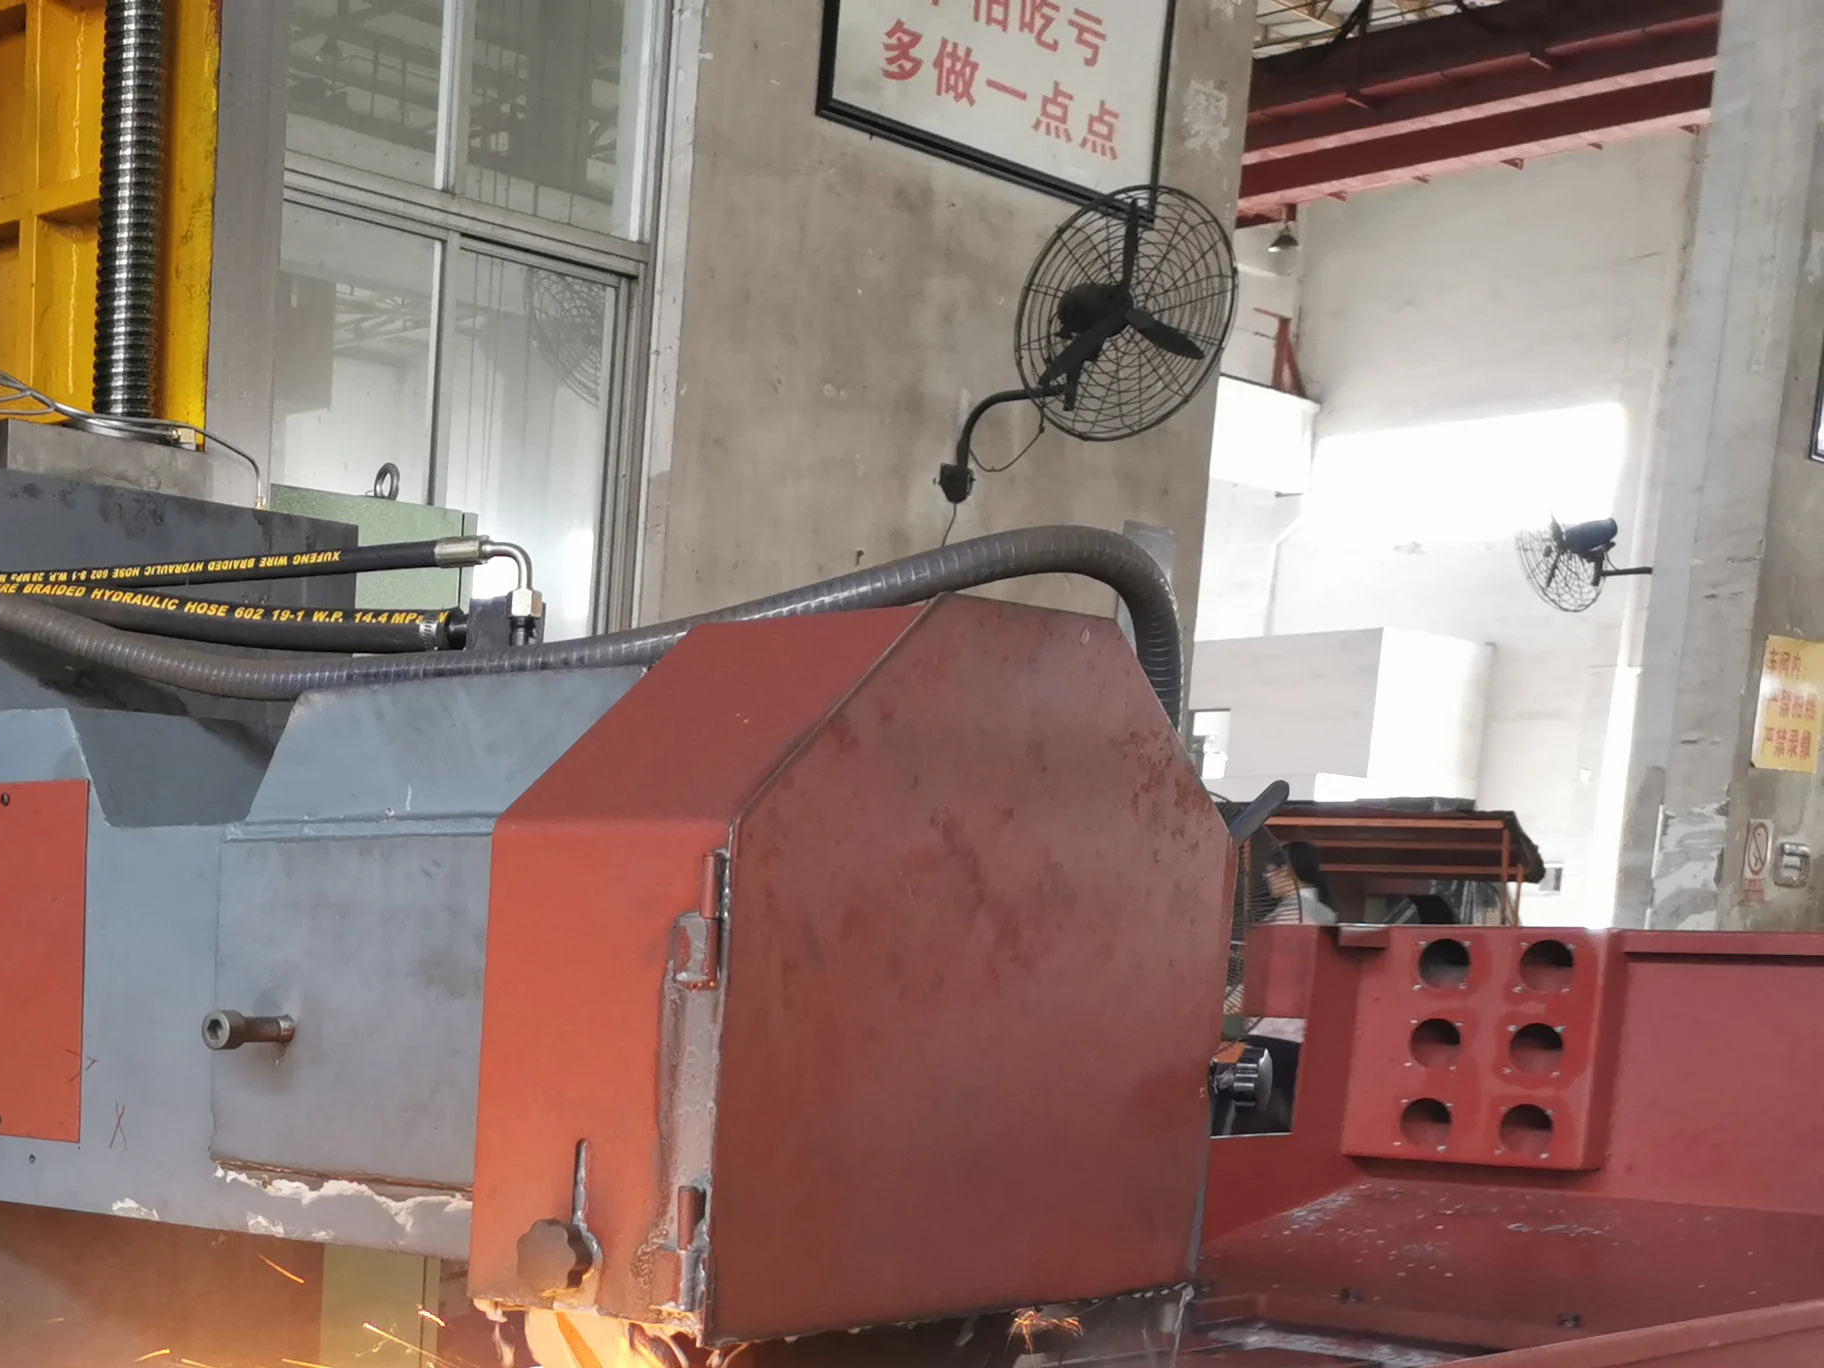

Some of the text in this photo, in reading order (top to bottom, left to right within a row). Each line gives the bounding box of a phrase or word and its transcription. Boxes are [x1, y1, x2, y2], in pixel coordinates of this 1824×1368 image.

[930, 0, 1107, 68] 怕吃亏
[880, 18, 1120, 161] 多做一点点
[208, 557, 256, 571] BRAIDED
[259, 555, 288, 568] WIRE
[292, 551, 342, 566] XUFENG
[90, 569, 109, 581] 602
[112, 567, 140, 579] HOSE
[144, 561, 204, 576] HYDRAULIC
[22, 583, 86, 598] BRAIDED
[91, 588, 179, 611] HYDRAULIC
[184, 600, 229, 618] HOSE
[234, 606, 265, 621] 602
[271, 609, 306, 623] 19-1
[312, 610, 344, 624] W.P.
